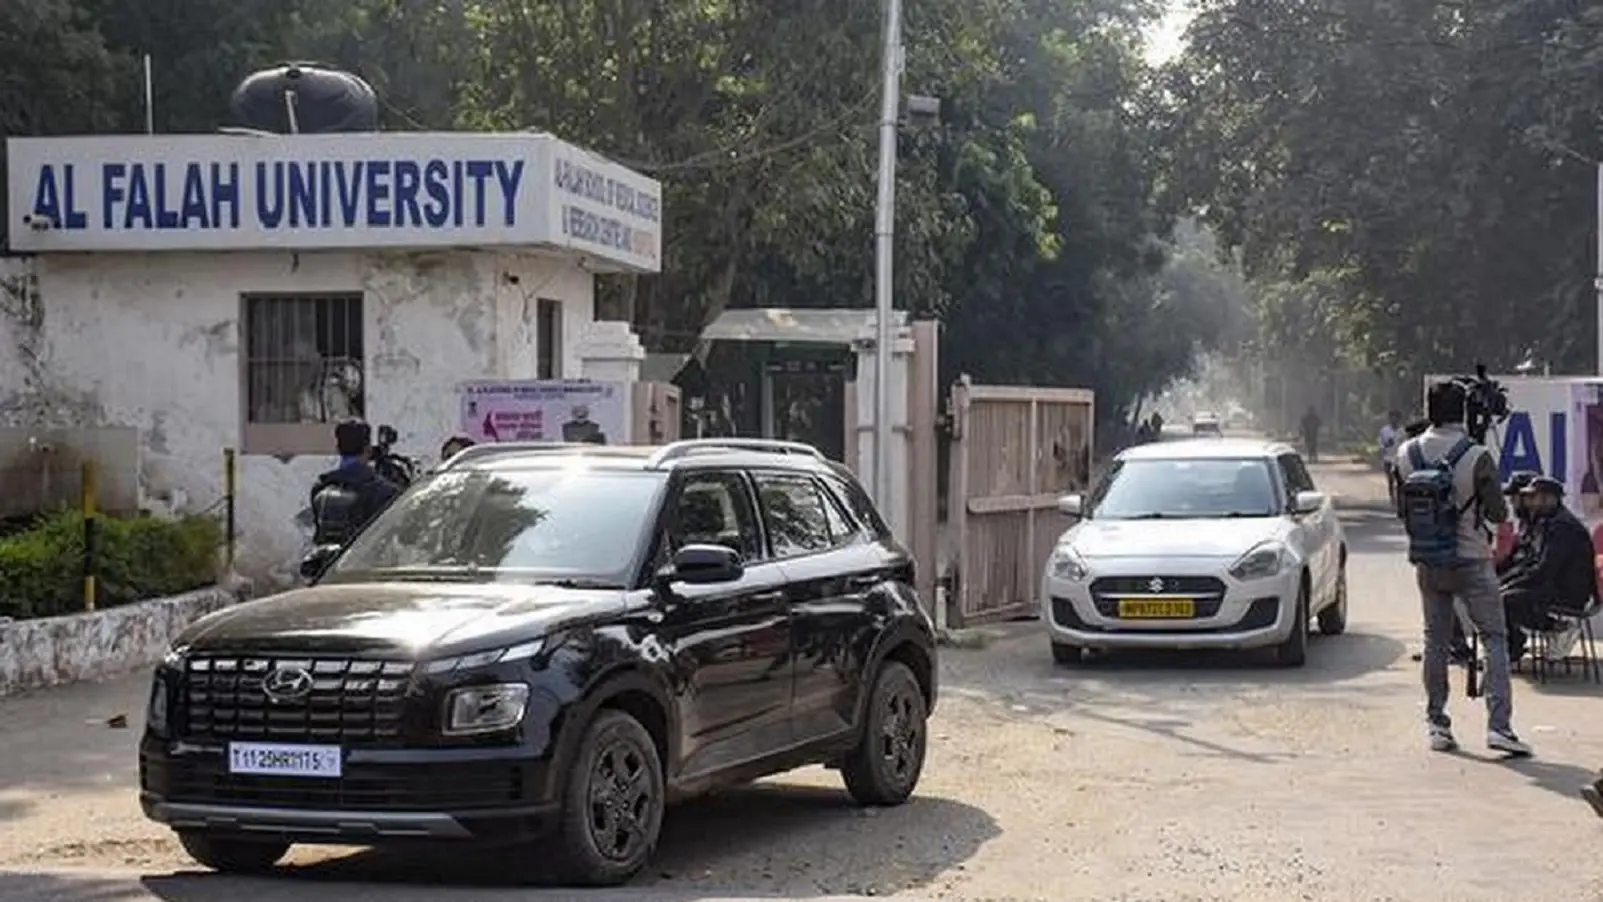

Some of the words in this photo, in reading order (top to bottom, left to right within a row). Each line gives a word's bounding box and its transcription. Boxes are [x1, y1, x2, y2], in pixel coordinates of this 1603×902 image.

[34, 163, 87, 229] AL
[103, 163, 240, 229] FALAH
[257, 161, 525, 228] UNIVERSITY
